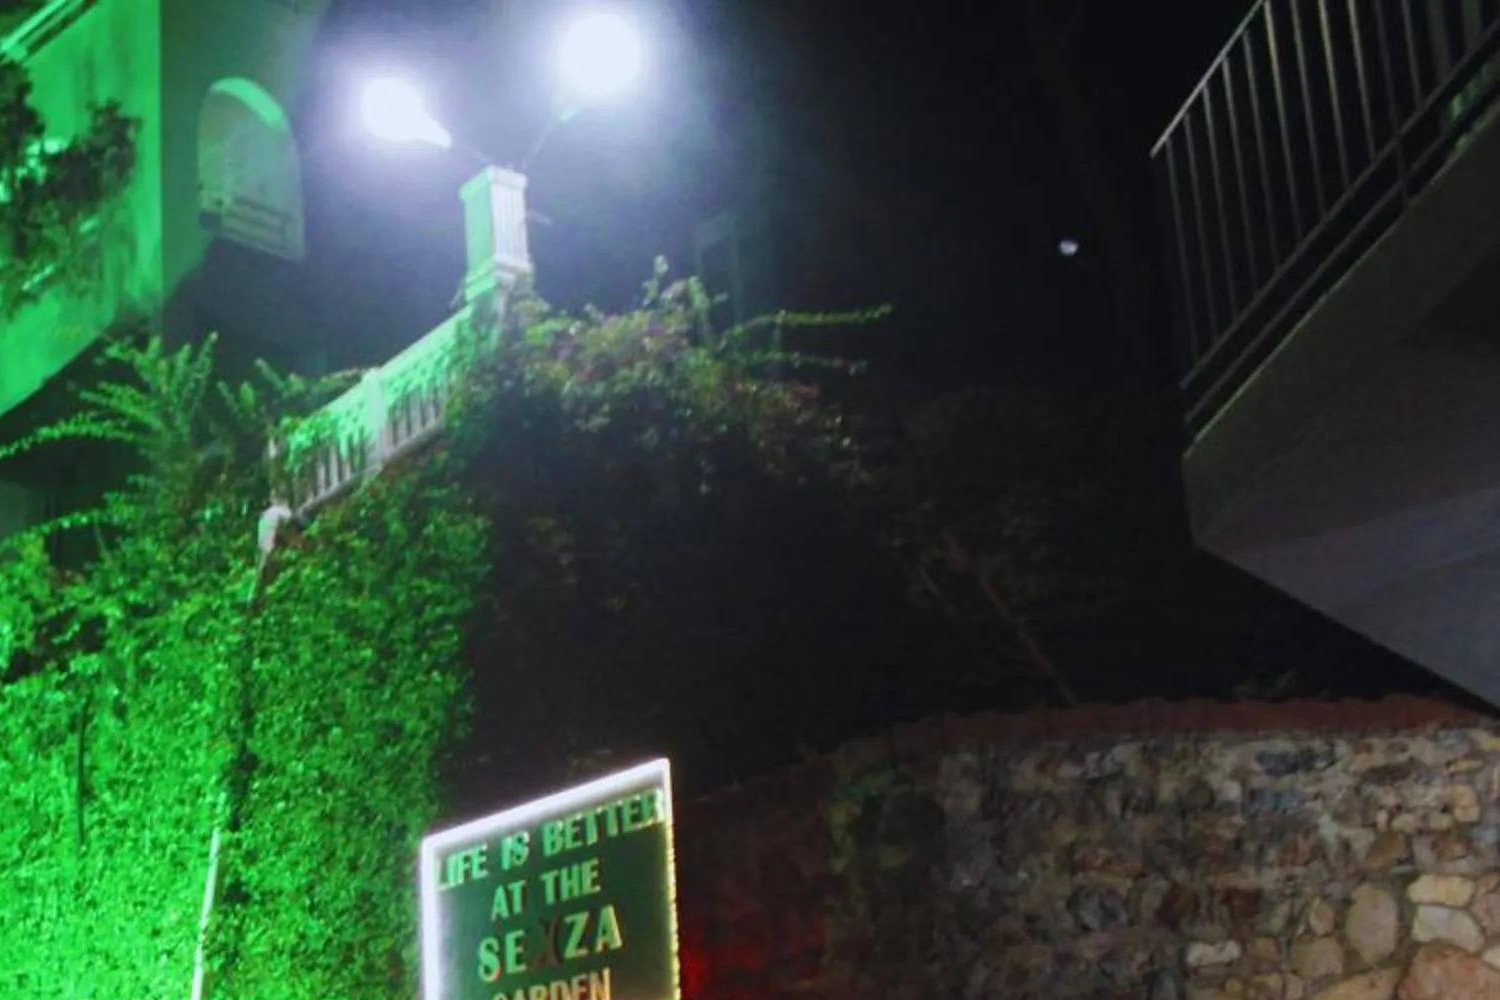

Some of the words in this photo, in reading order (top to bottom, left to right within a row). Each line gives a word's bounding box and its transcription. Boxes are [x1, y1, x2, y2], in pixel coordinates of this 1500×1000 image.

[434, 843, 488, 892] LIFE
[501, 830, 529, 871] IS
[543, 788, 667, 857] BETTER
[491, 879, 527, 922] AT
[540, 858, 601, 905] THE
